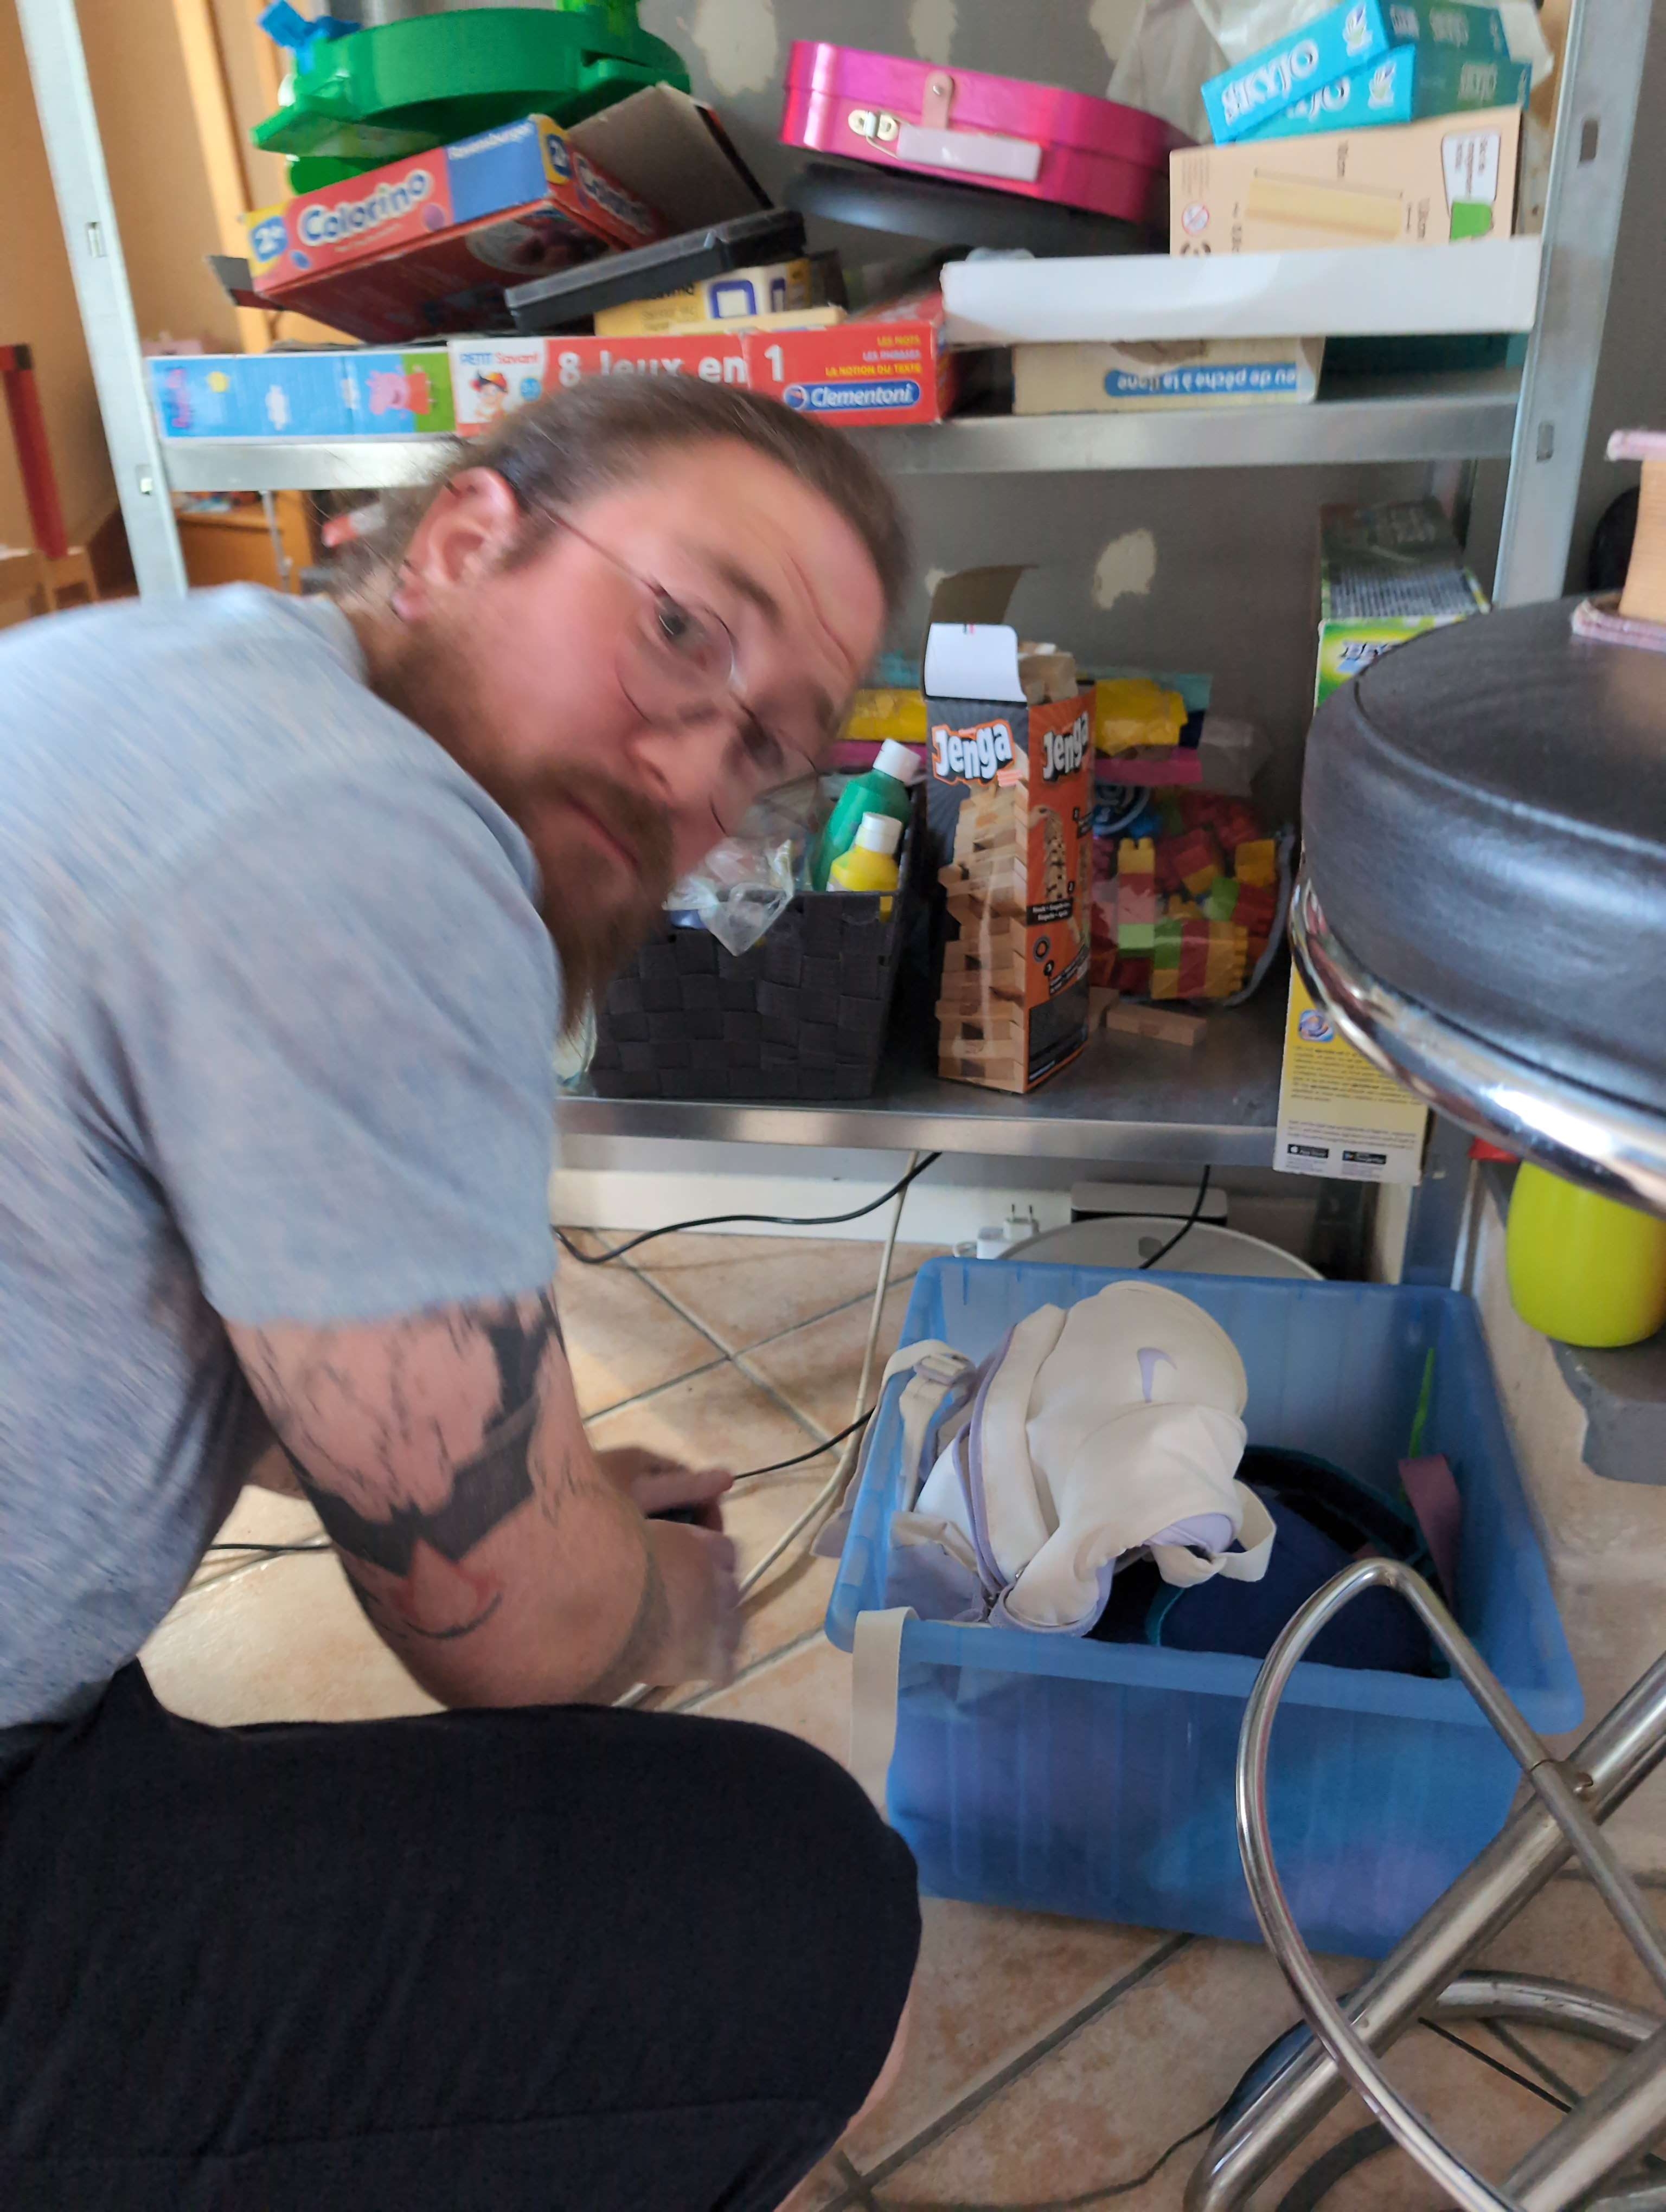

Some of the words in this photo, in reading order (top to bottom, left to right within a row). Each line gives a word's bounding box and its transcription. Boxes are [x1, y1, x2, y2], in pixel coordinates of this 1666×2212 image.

[299, 170, 433, 246] Colorino
[558, 351, 581, 387] 8
[699, 356, 747, 383] en
[765, 345, 784, 382] 1
[840, 364, 875, 375] NOTION
[877, 364, 891, 374] DU
[893, 362, 921, 374] TEXTE
[1250, 369, 1272, 387] de
[1275, 368, 1296, 385] eu
[934, 724, 1013, 779] Jenga
[1043, 711, 1088, 780] Jenga
